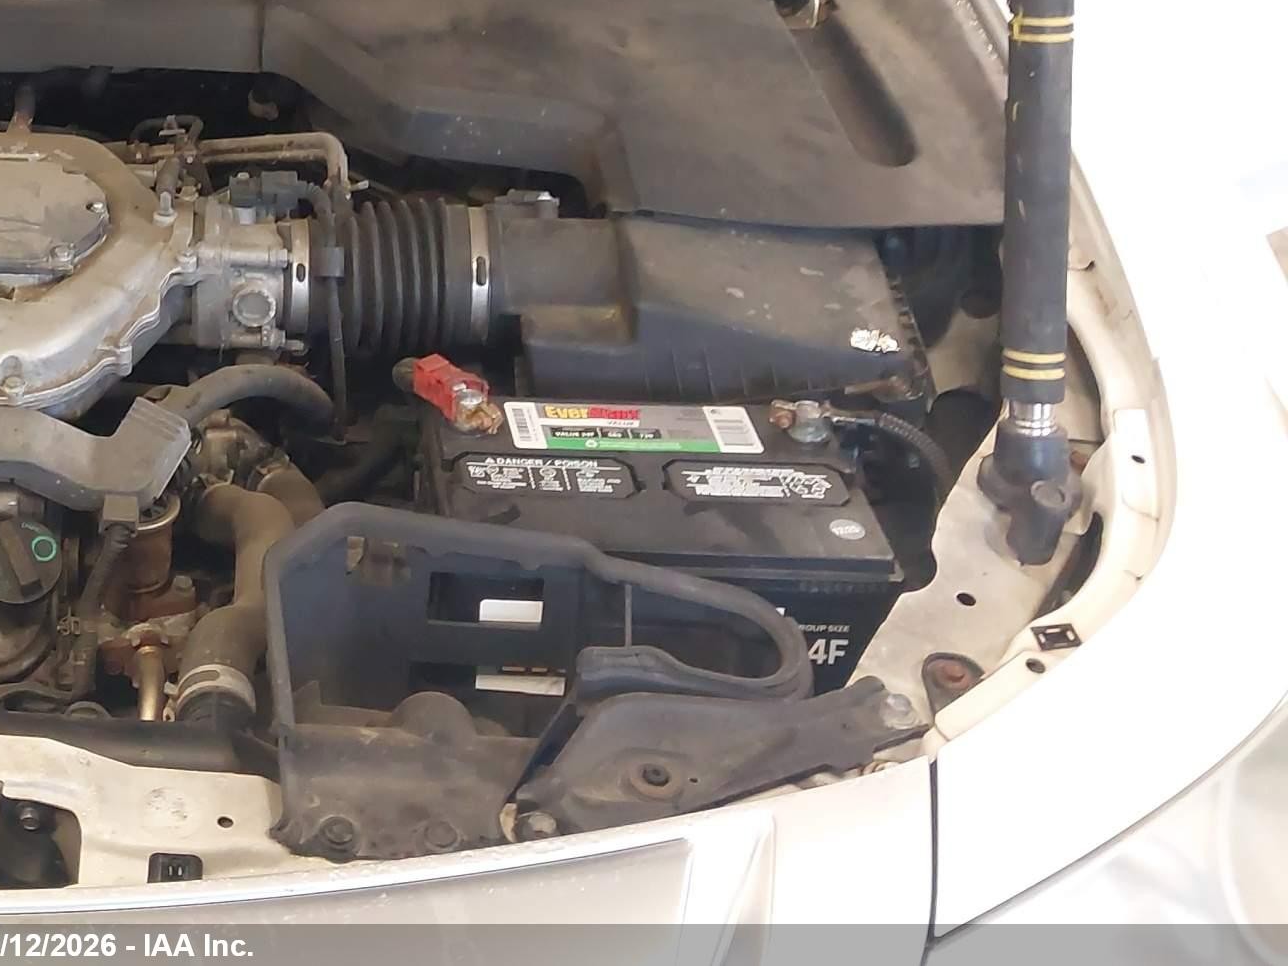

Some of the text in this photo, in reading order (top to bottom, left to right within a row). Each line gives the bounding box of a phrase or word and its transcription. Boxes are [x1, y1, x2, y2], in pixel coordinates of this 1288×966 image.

[497, 457, 543, 466] DANGER
[554, 460, 598, 468] POISON
[828, 624, 850, 633] SIZE
